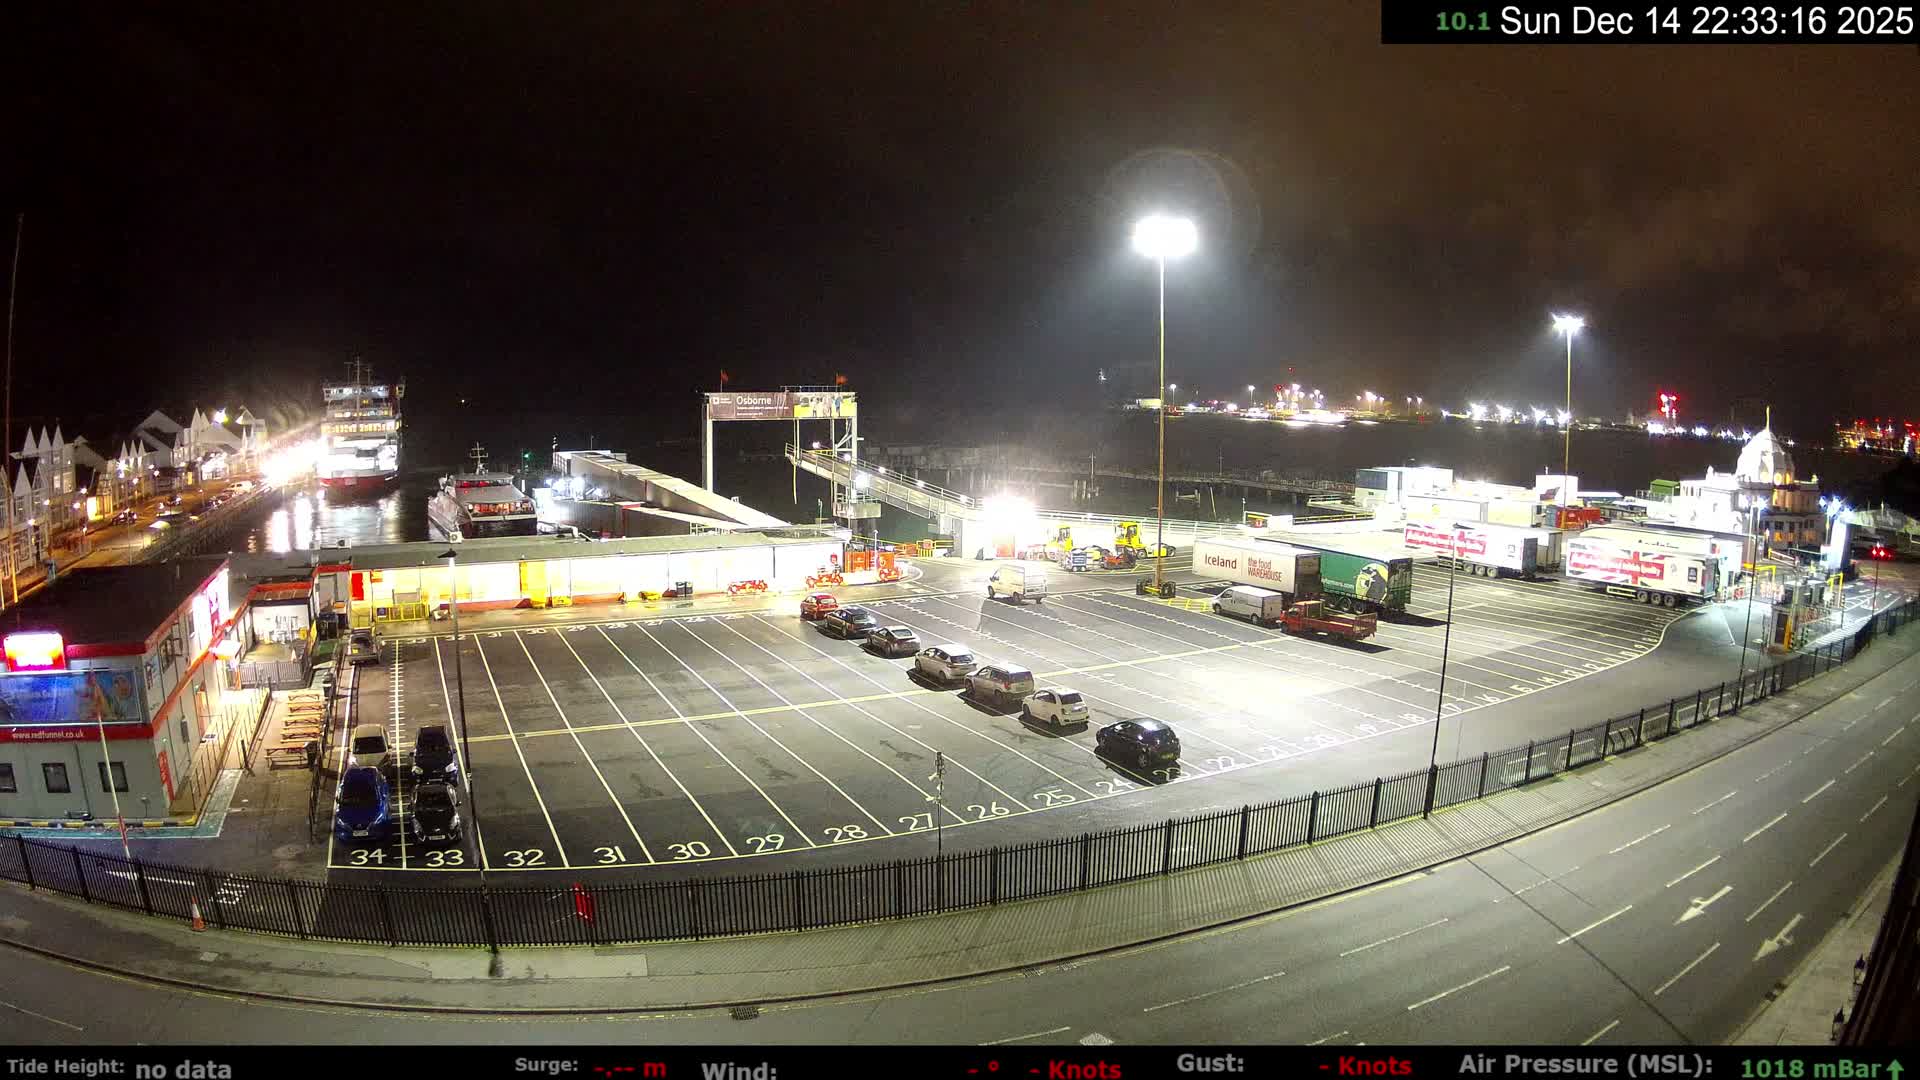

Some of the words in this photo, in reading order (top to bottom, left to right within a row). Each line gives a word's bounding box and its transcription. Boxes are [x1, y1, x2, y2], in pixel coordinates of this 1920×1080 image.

[736, 395, 772, 405] Osborne
[1205, 553, 1237, 569] Iceland
[1247, 556, 1257, 567] the
[1258, 558, 1272, 569] food
[1247, 566, 1282, 583] WAREHOUSE
[488, 630, 503, 638] 31
[1511, 683, 1534, 694] 15
[1475, 693, 1501, 704] 16
[13, 728, 85, 740] www.redfunnel.co.uk
[1208, 756, 1247, 773] 22
[1152, 767, 1191, 783] 23
[1096, 776, 1136, 794] 24
[1034, 789, 1076, 807] 25
[967, 801, 1010, 820] 26
[899, 813, 934, 831] 27
[824, 824, 868, 844] 28
[667, 840, 711, 861] 30
[746, 833, 786, 854] 29
[350, 848, 388, 865] 34
[425, 848, 465, 868] 33
[505, 848, 547, 868] 32
[593, 845, 625, 864] 31
